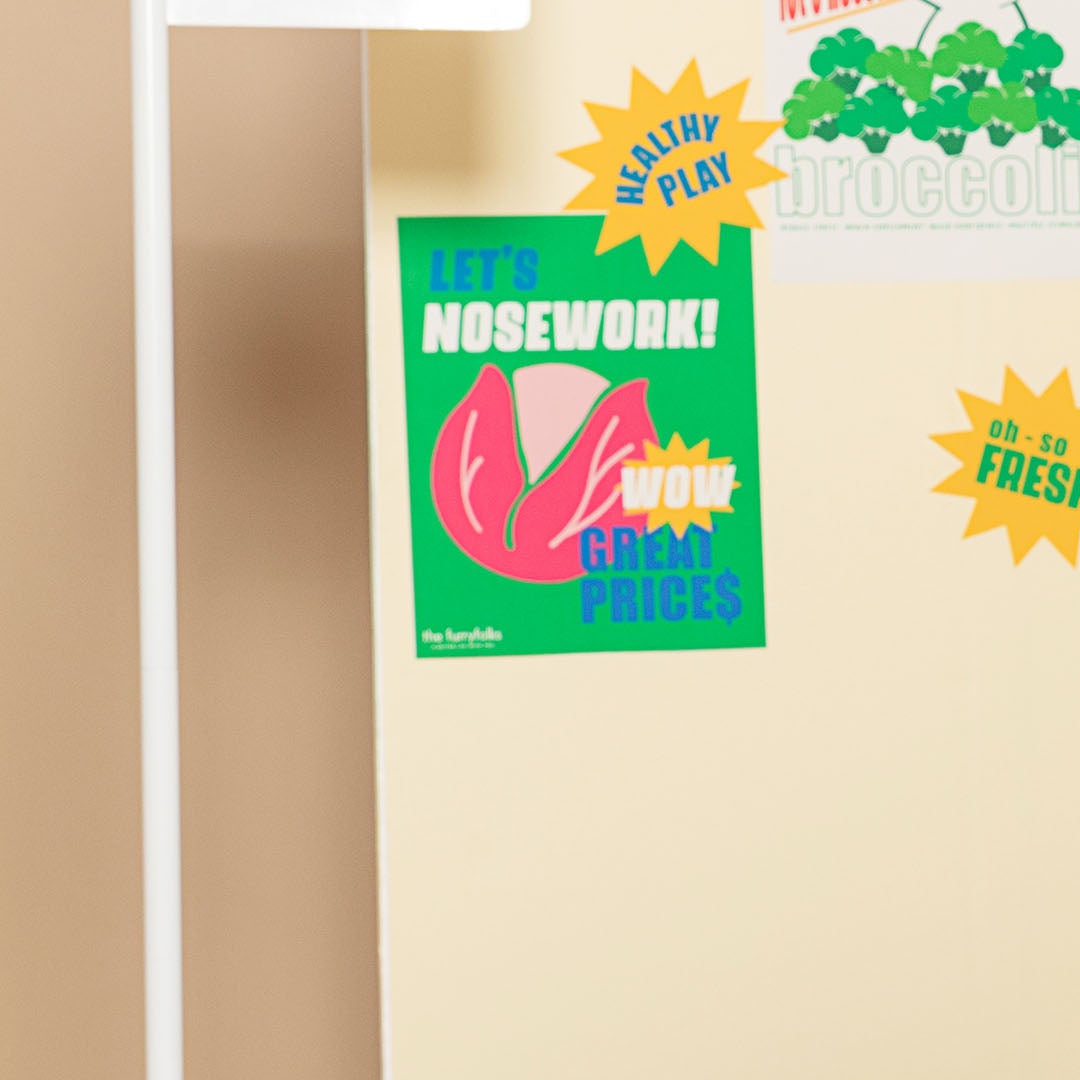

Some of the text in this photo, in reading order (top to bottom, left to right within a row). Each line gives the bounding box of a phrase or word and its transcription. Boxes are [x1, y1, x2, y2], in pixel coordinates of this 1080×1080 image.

[616, 113, 720, 204] HEALTHY
[657, 151, 731, 207] PLAY
[429, 245, 539, 291] LET'S
[422, 299, 719, 353] NOSEWORK!
[990, 419, 1018, 443] oh
[1040, 433, 1067, 456] so
[621, 464, 737, 510] WOW
[580, 523, 718, 573] GREAT
[581, 567, 742, 626] PRICE$
[421, 628, 444, 643] the
